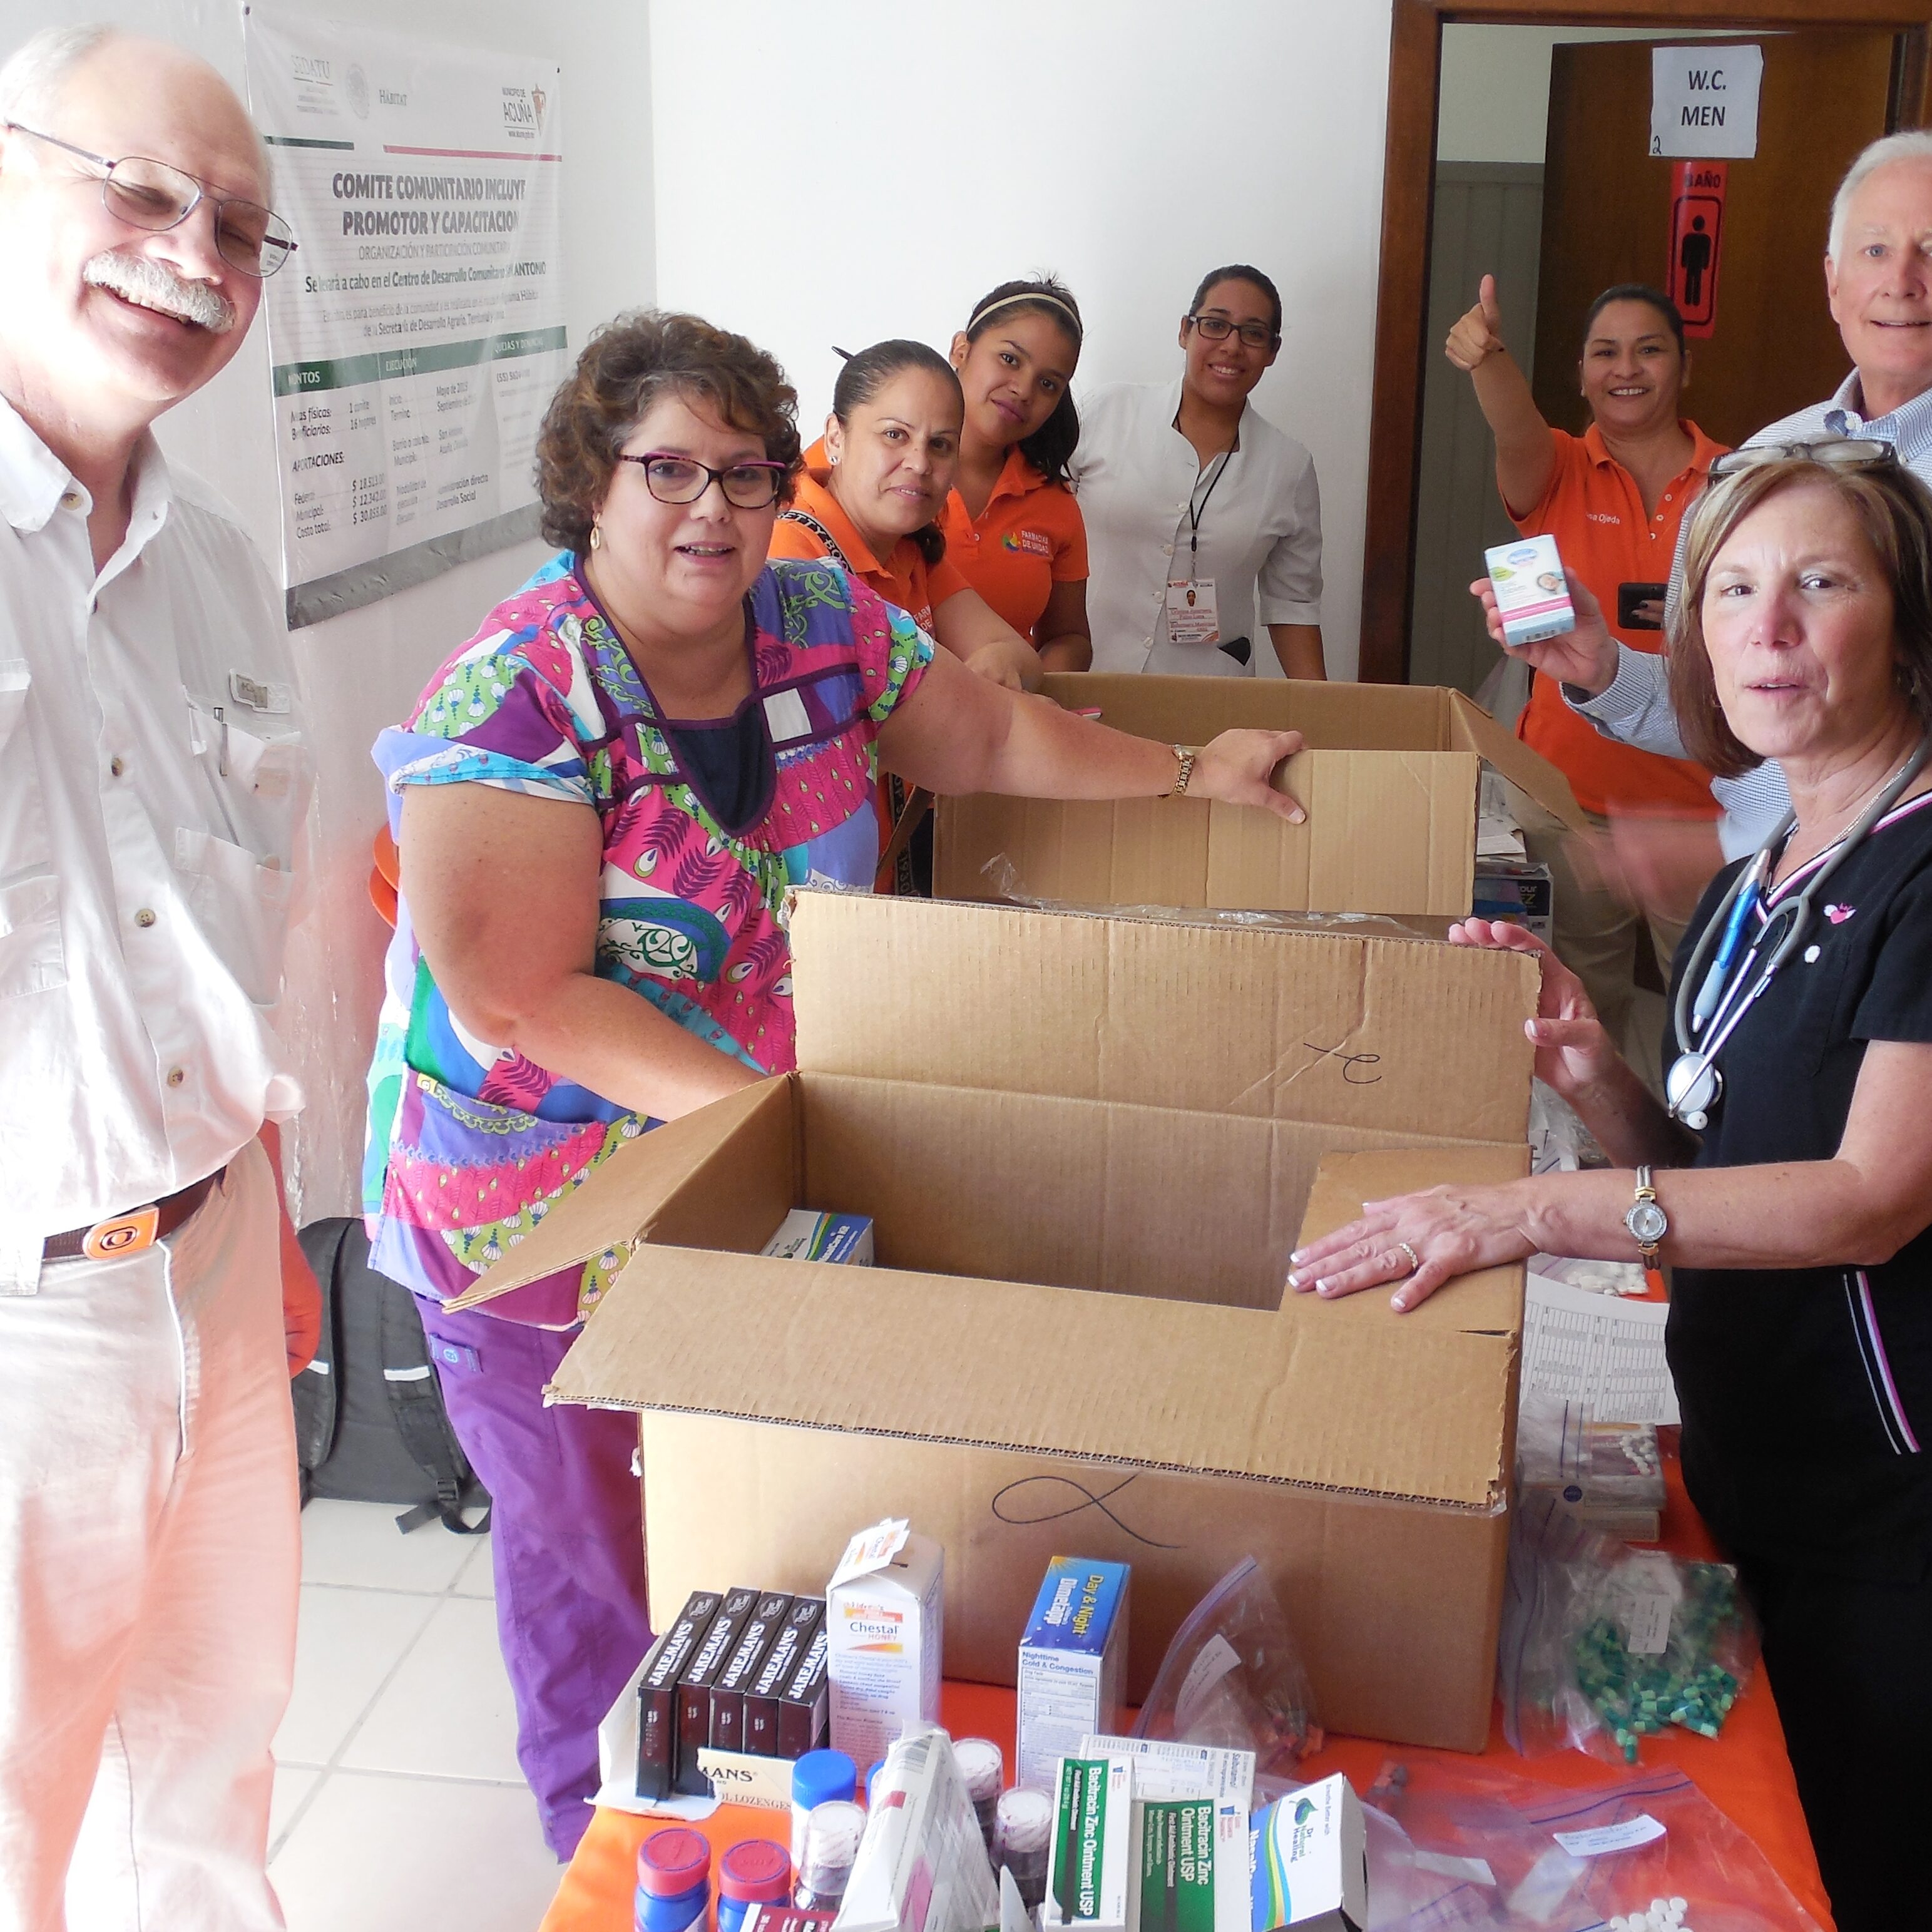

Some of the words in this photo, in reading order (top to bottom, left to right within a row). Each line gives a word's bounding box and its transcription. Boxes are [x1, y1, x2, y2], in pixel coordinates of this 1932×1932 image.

[1688, 69, 1727, 91] W.C.
[503, 99, 534, 123] ACUÑA
[1680, 106, 1725, 126] MEN
[1652, 135, 1662, 155] 2
[332, 173, 393, 200] COMITE
[396, 175, 484, 201] COMUNITARIO
[343, 211, 429, 235] PROMOTOR
[431, 212, 441, 234] Y
[305, 275, 318, 293] Se
[341, 277, 349, 290] a
[349, 273, 371, 290] cabo
[371, 276, 382, 289] en
[383, 272, 391, 288] el
[392, 271, 419, 287] Centro
[421, 270, 430, 285] de
[431, 268, 467, 284] Desarrollo
[514, 260, 546, 277] ANTONIO
[410, 317, 417, 332] de
[289, 371, 320, 387] NTOS
[309, 406, 332, 422] físicas:
[292, 424, 332, 441] Bficiarios:
[920, 619, 933, 631] DE
[1082, 1575, 1105, 1595] Day
[1083, 1596, 1097, 1604] &
[850, 1622, 897, 1635] Chestal
[1072, 1606, 1095, 1635] Night
[648, 1621, 693, 1686] JAKEMANS
[688, 1617, 732, 1683] JAKEMANS
[722, 1622, 765, 1687] JAKEMANS
[755, 1627, 799, 1694] JAKEMANS
[1022, 1651, 1060, 1663] Nighttime
[1022, 1659, 1040, 1667] Cold
[1049, 1662, 1094, 1675] Congestion
[735, 1793, 792, 1810] LOZENGES
[1086, 1766, 1102, 1816] Bacitracin
[1085, 1816, 1099, 1839] Zinc
[1181, 1807, 1195, 1857] Ointment
[1198, 1806, 1212, 1860] Bacitracin
[1306, 1827, 1314, 1838] Dr
[1291, 1827, 1299, 1864] Healing
[1299, 1824, 1307, 1858] Natural
[1081, 1839, 1098, 1891] Ointment
[1180, 1857, 1194, 1882] USP
[1197, 1861, 1212, 1885] Zinc
[1079, 1891, 1095, 1916] USP
